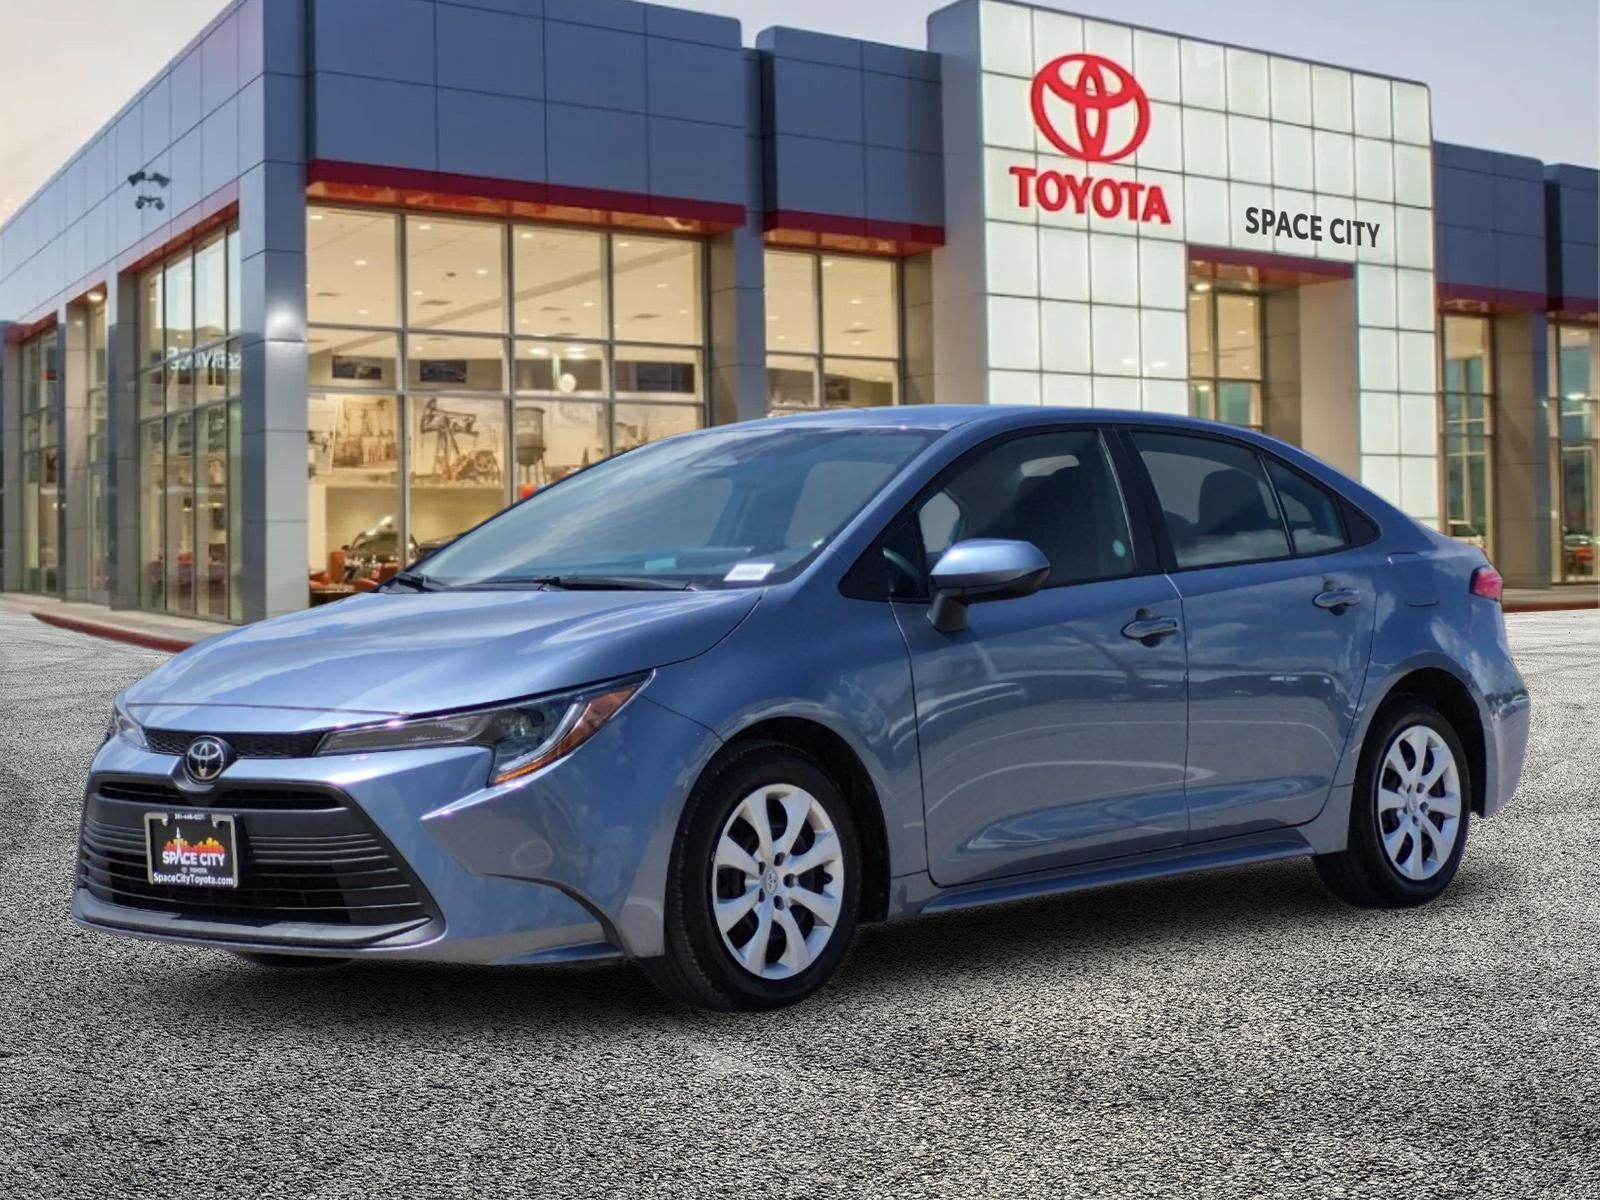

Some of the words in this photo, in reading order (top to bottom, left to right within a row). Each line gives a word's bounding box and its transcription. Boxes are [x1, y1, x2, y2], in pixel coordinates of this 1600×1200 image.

[1009, 166, 1171, 224] TOYOTA
[1245, 206, 1322, 241] SPACE
[1329, 218, 1380, 248] CITY
[162, 850, 197, 865] SPACE
[199, 853, 225, 867] CITY
[153, 872, 234, 886] SpaceCityToyota.com
